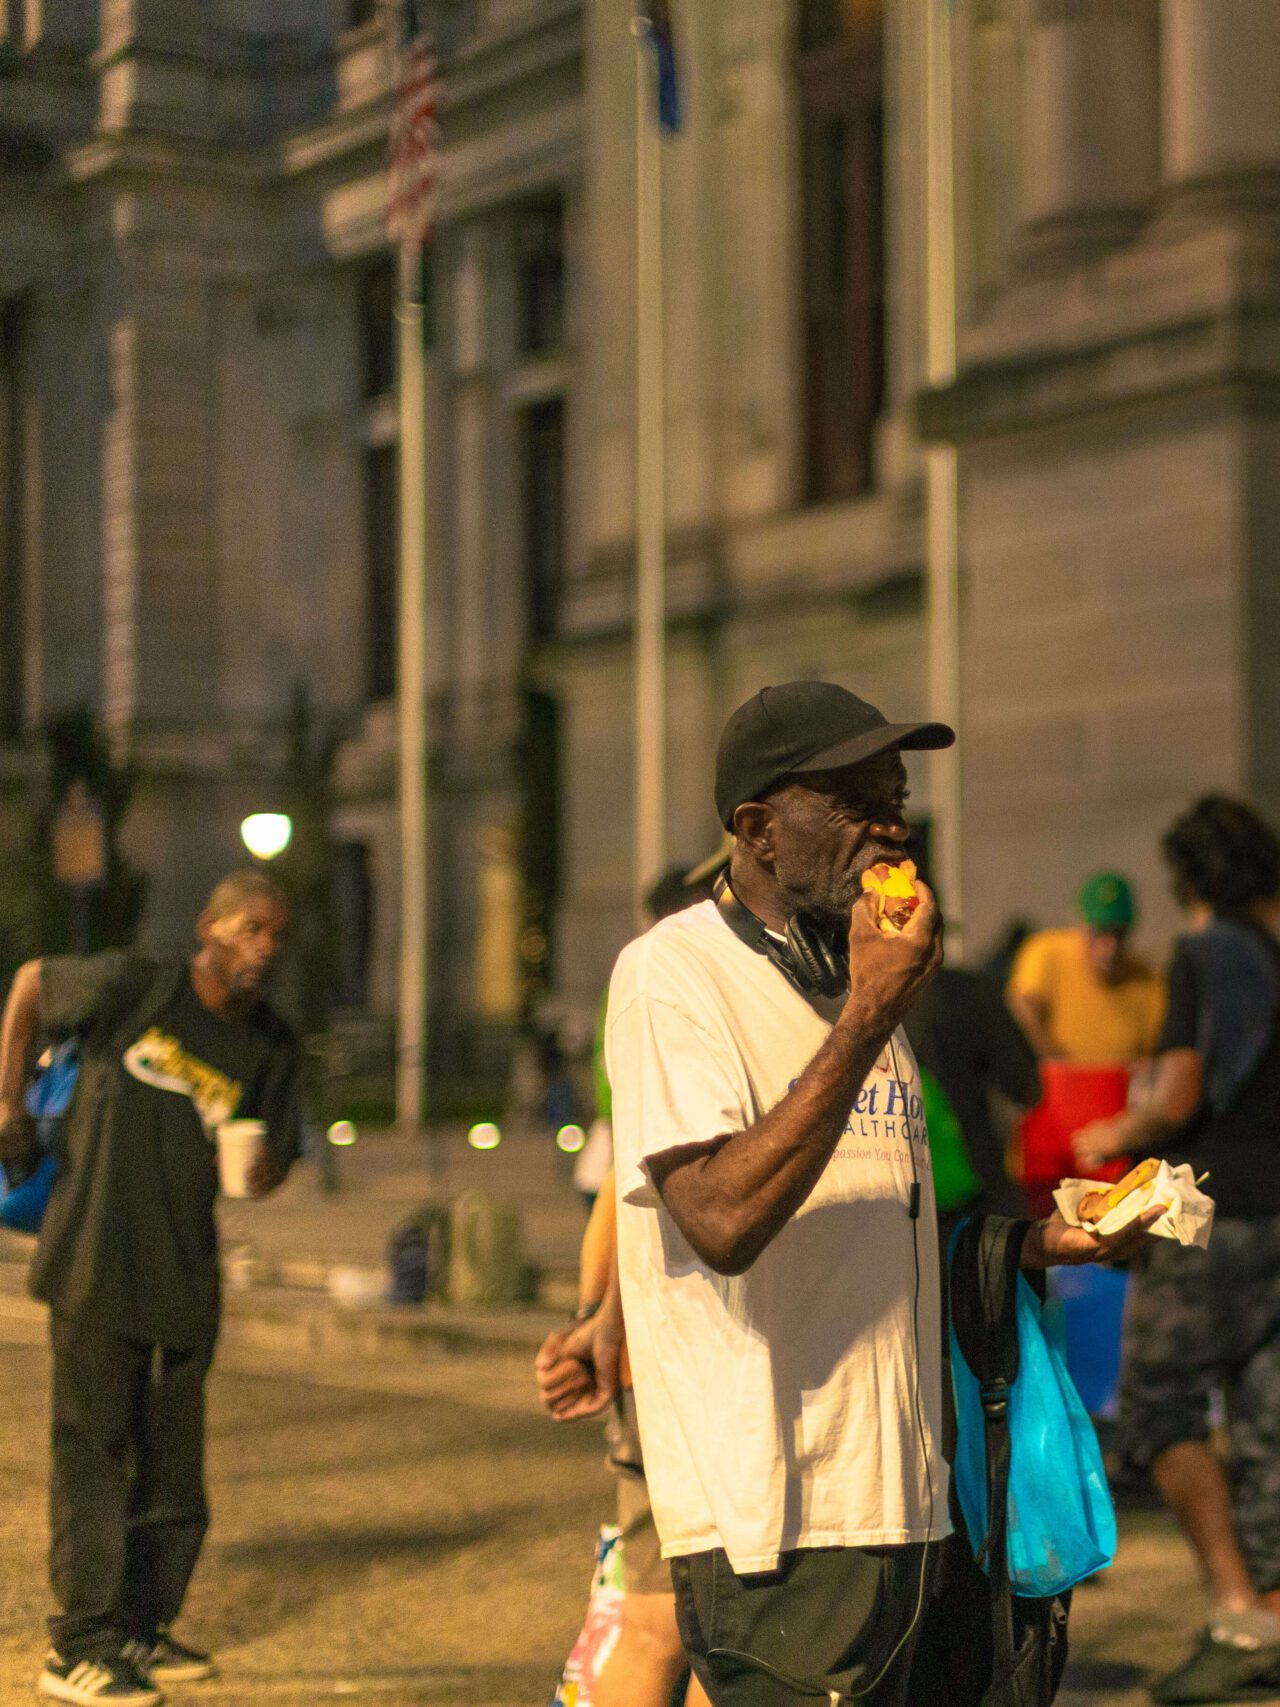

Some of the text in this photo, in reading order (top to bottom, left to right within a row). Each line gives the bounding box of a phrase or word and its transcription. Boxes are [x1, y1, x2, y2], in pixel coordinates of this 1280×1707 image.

[843, 1118, 928, 1146] ALTHCAR
[832, 1147, 872, 1163] passion
[875, 1148, 891, 1161] You
